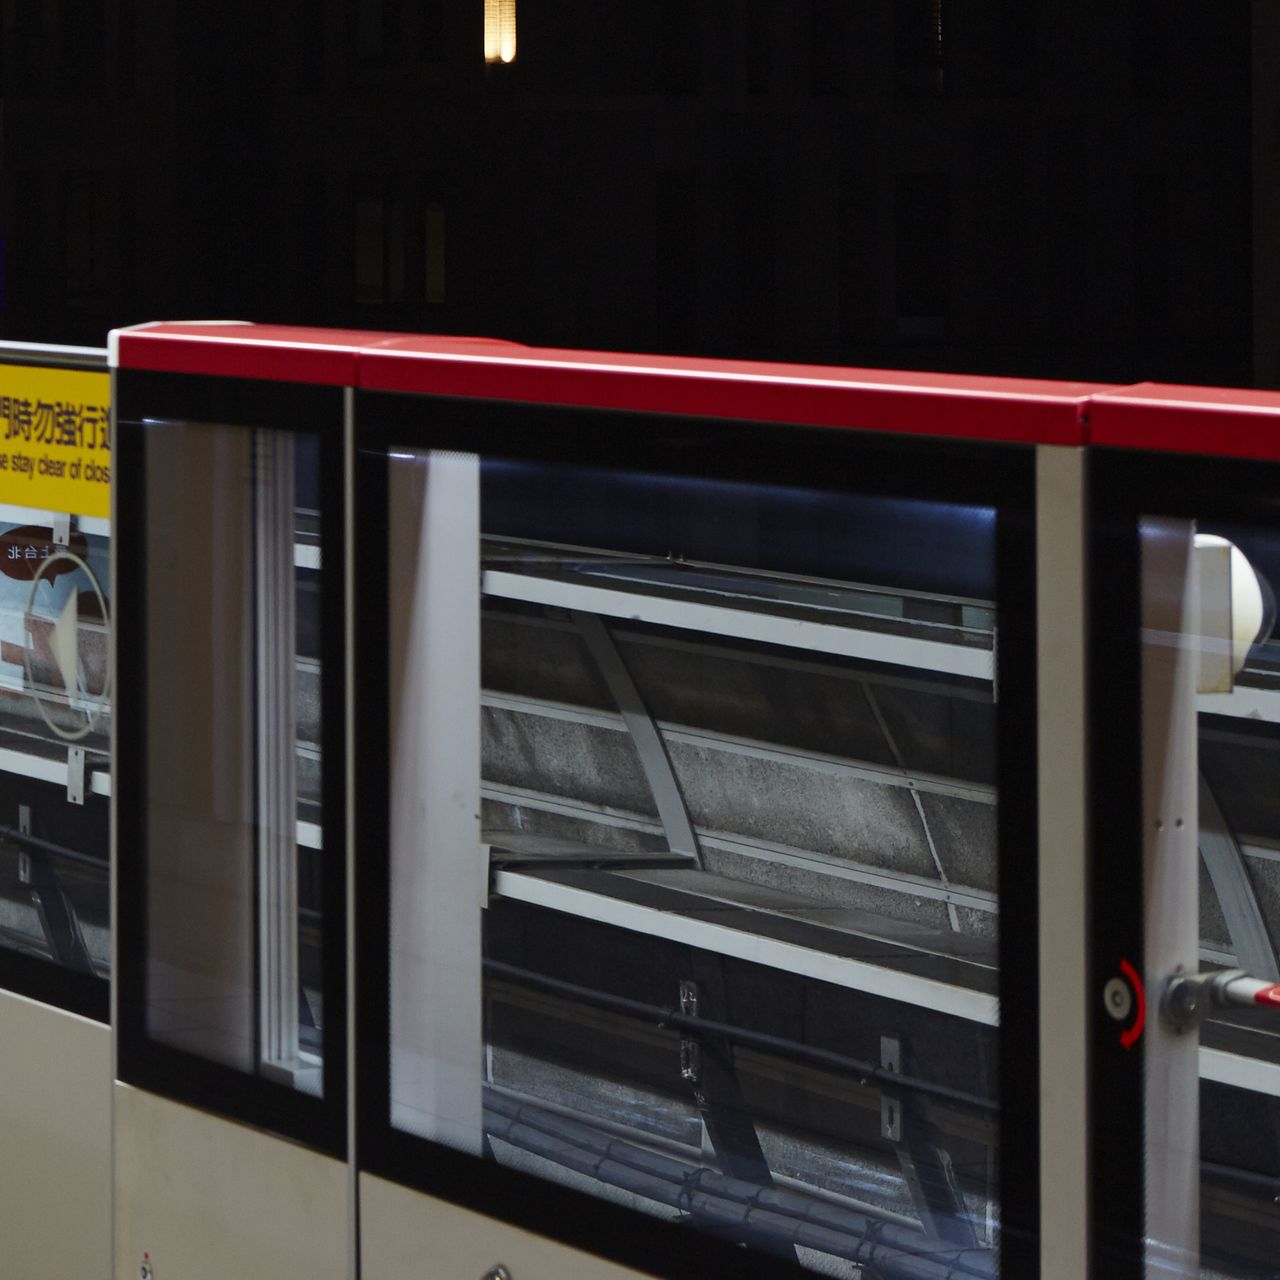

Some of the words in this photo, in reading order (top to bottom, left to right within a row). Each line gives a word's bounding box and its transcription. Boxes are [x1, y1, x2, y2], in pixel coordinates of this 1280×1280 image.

[11, 451, 35, 479] stay
[38, 454, 66, 478] clear
[69, 457, 83, 480] of
